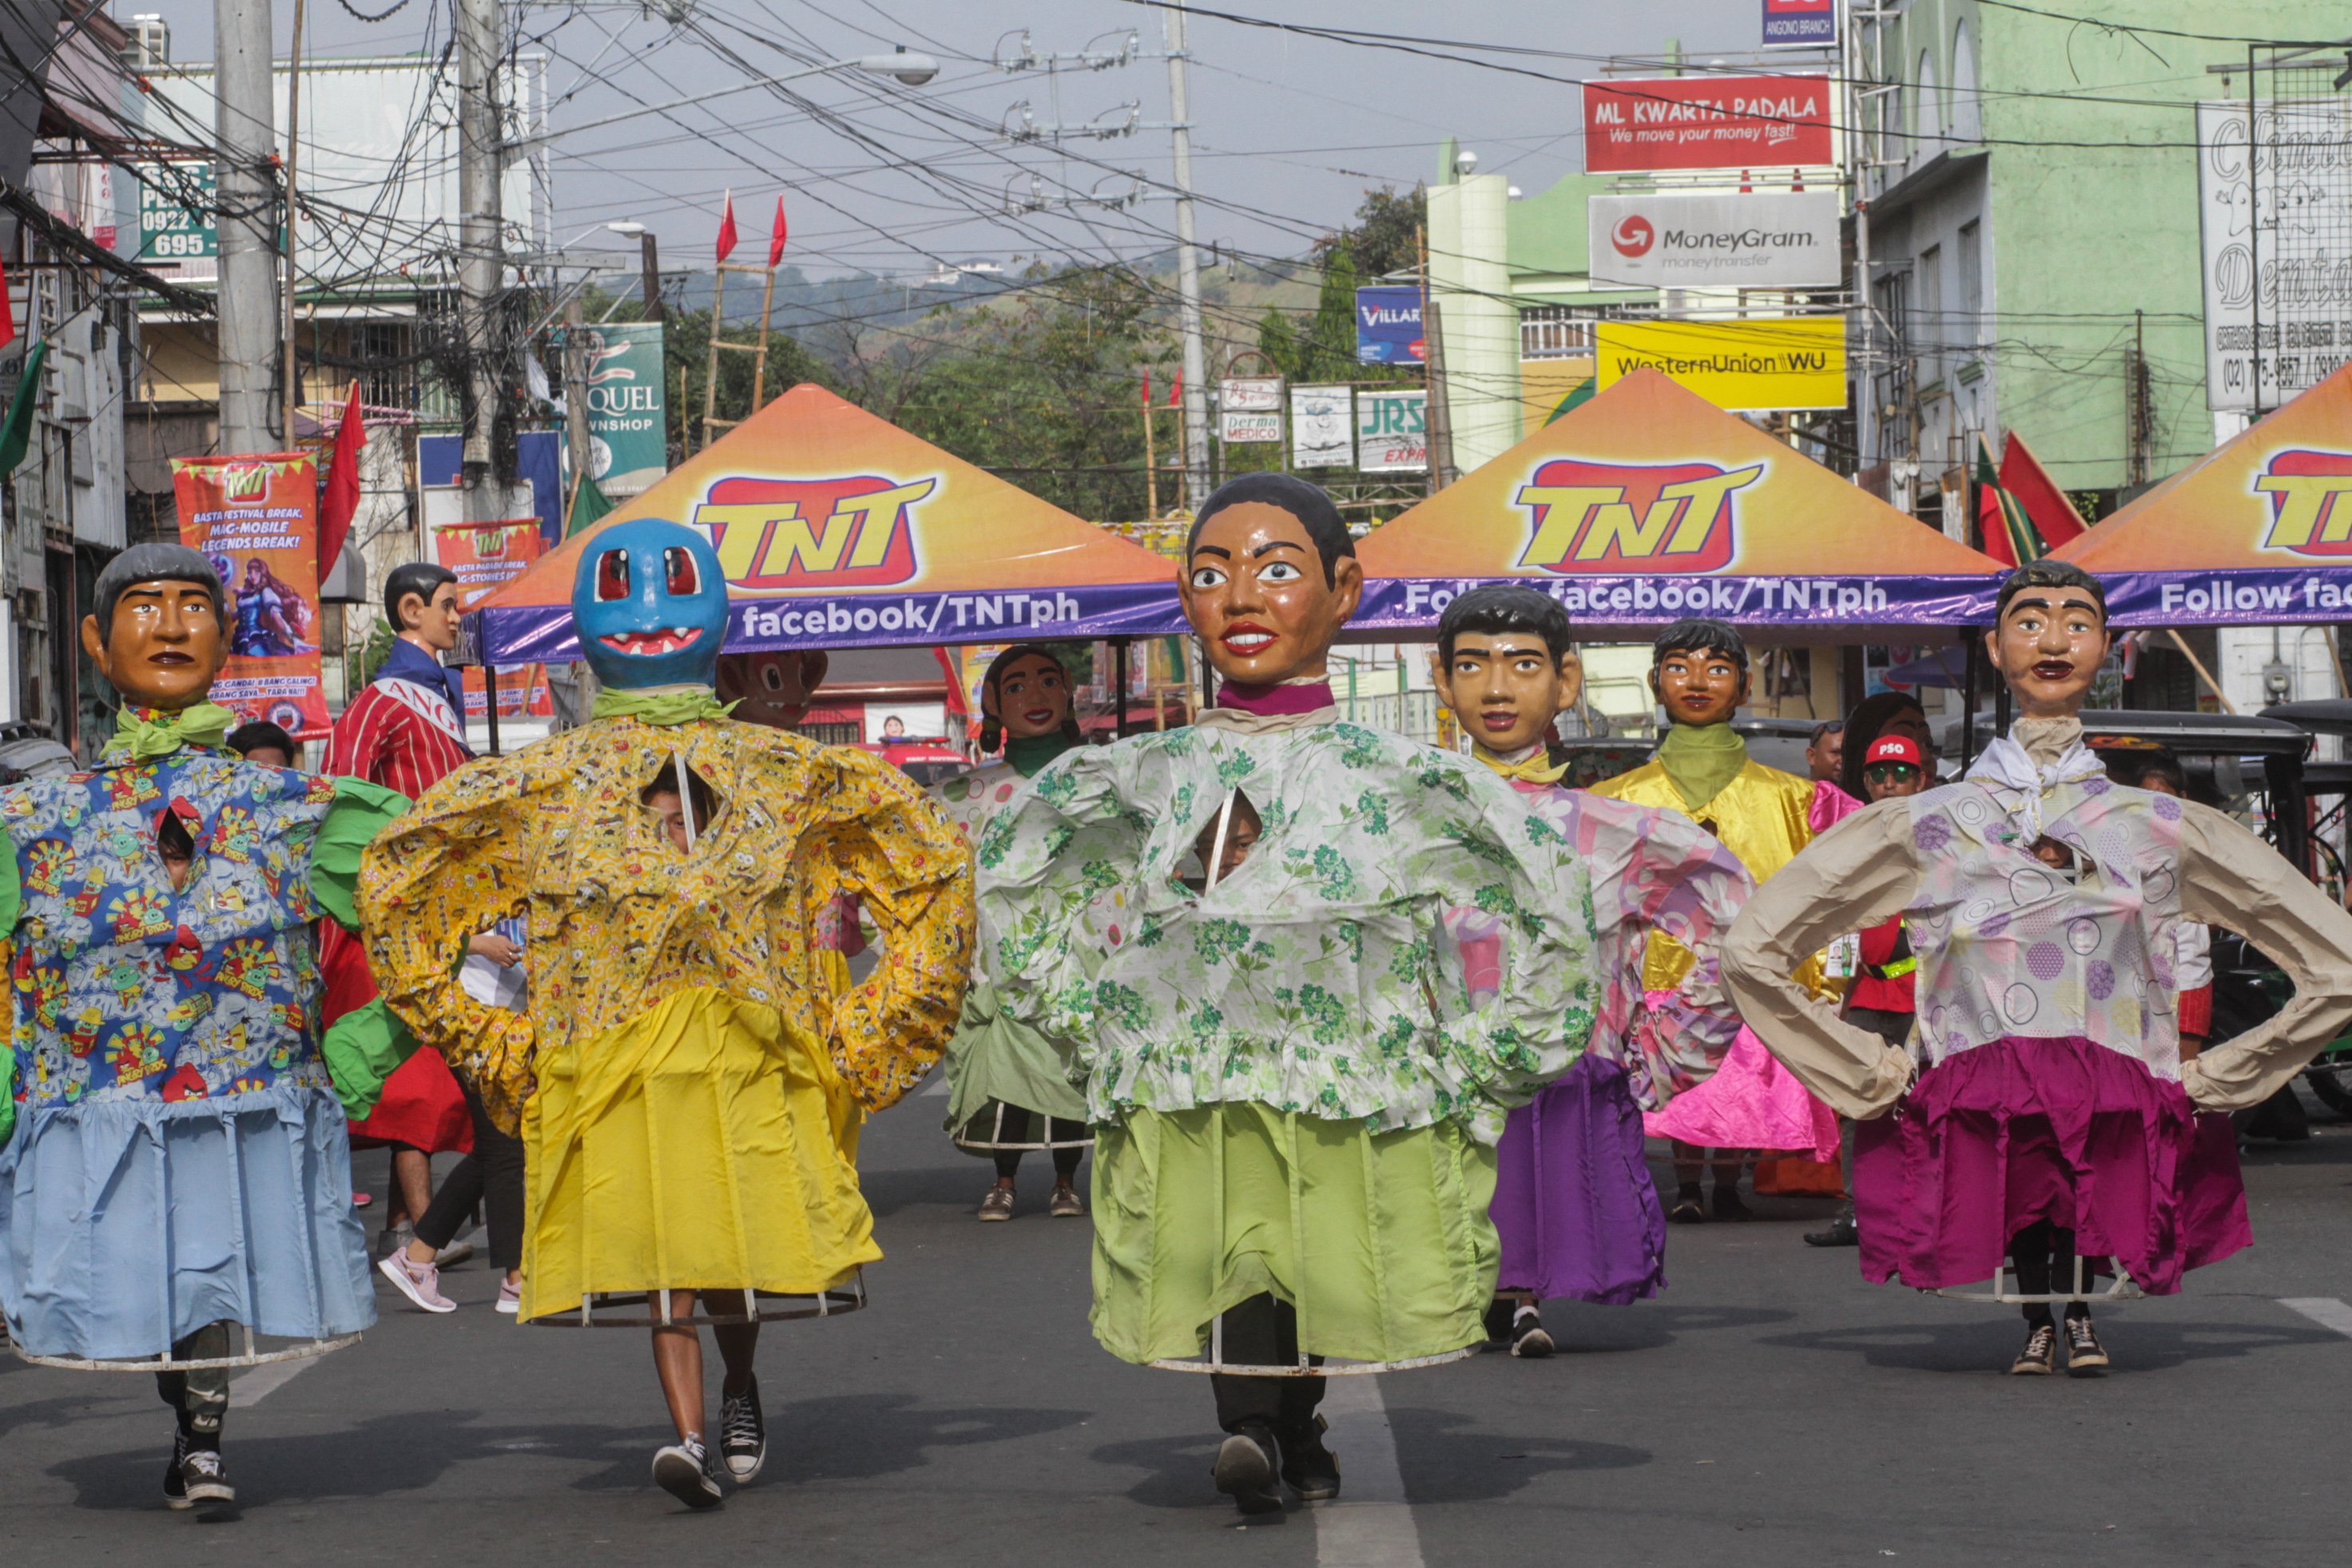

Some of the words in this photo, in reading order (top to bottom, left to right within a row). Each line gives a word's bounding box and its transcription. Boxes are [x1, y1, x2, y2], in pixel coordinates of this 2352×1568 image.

[1766, 21, 1798, 35] ANGONO
[1800, 19, 1831, 34] BRANCH
[1595, 102, 1626, 125] ML
[1634, 99, 1726, 124] KWARTA
[1734, 97, 1817, 118] PADALA
[1610, 128, 1632, 143] We
[1637, 129, 1675, 142] move
[1679, 128, 1710, 145] your
[1714, 125, 1762, 143] money
[1765, 123, 1796, 141] fast!
[142, 211, 189, 231] 0922
[155, 234, 204, 256] 695
[1663, 228, 1814, 252] MoneyGram
[1787, 351, 1826, 371] WU
[2223, 357, 2245, 395] (02)
[2248, 356, 2301, 387] 75-9557
[587, 386, 660, 417] QUEL
[588, 419, 654, 431] WNSHOP
[1228, 416, 1277, 428] Derma
[1361, 399, 1425, 435] JRS
[1227, 428, 1277, 440] MEDICO
[224, 466, 273, 498] TNT
[193, 510, 224, 523] BASTA
[224, 508, 265, 520] FESTIVAL
[1516, 463, 1764, 567] TNT
[210, 521, 290, 538] MAG-MOBILE
[694, 477, 936, 582] TNT
[201, 537, 252, 553] LEGENDS
[252, 535, 301, 549] BREAK!
[1549, 580, 1887, 616] facebook/TNTph
[2162, 580, 2292, 613] Follow
[743, 592, 1080, 638] facebook/TNTph
[388, 681, 463, 738] ANG
